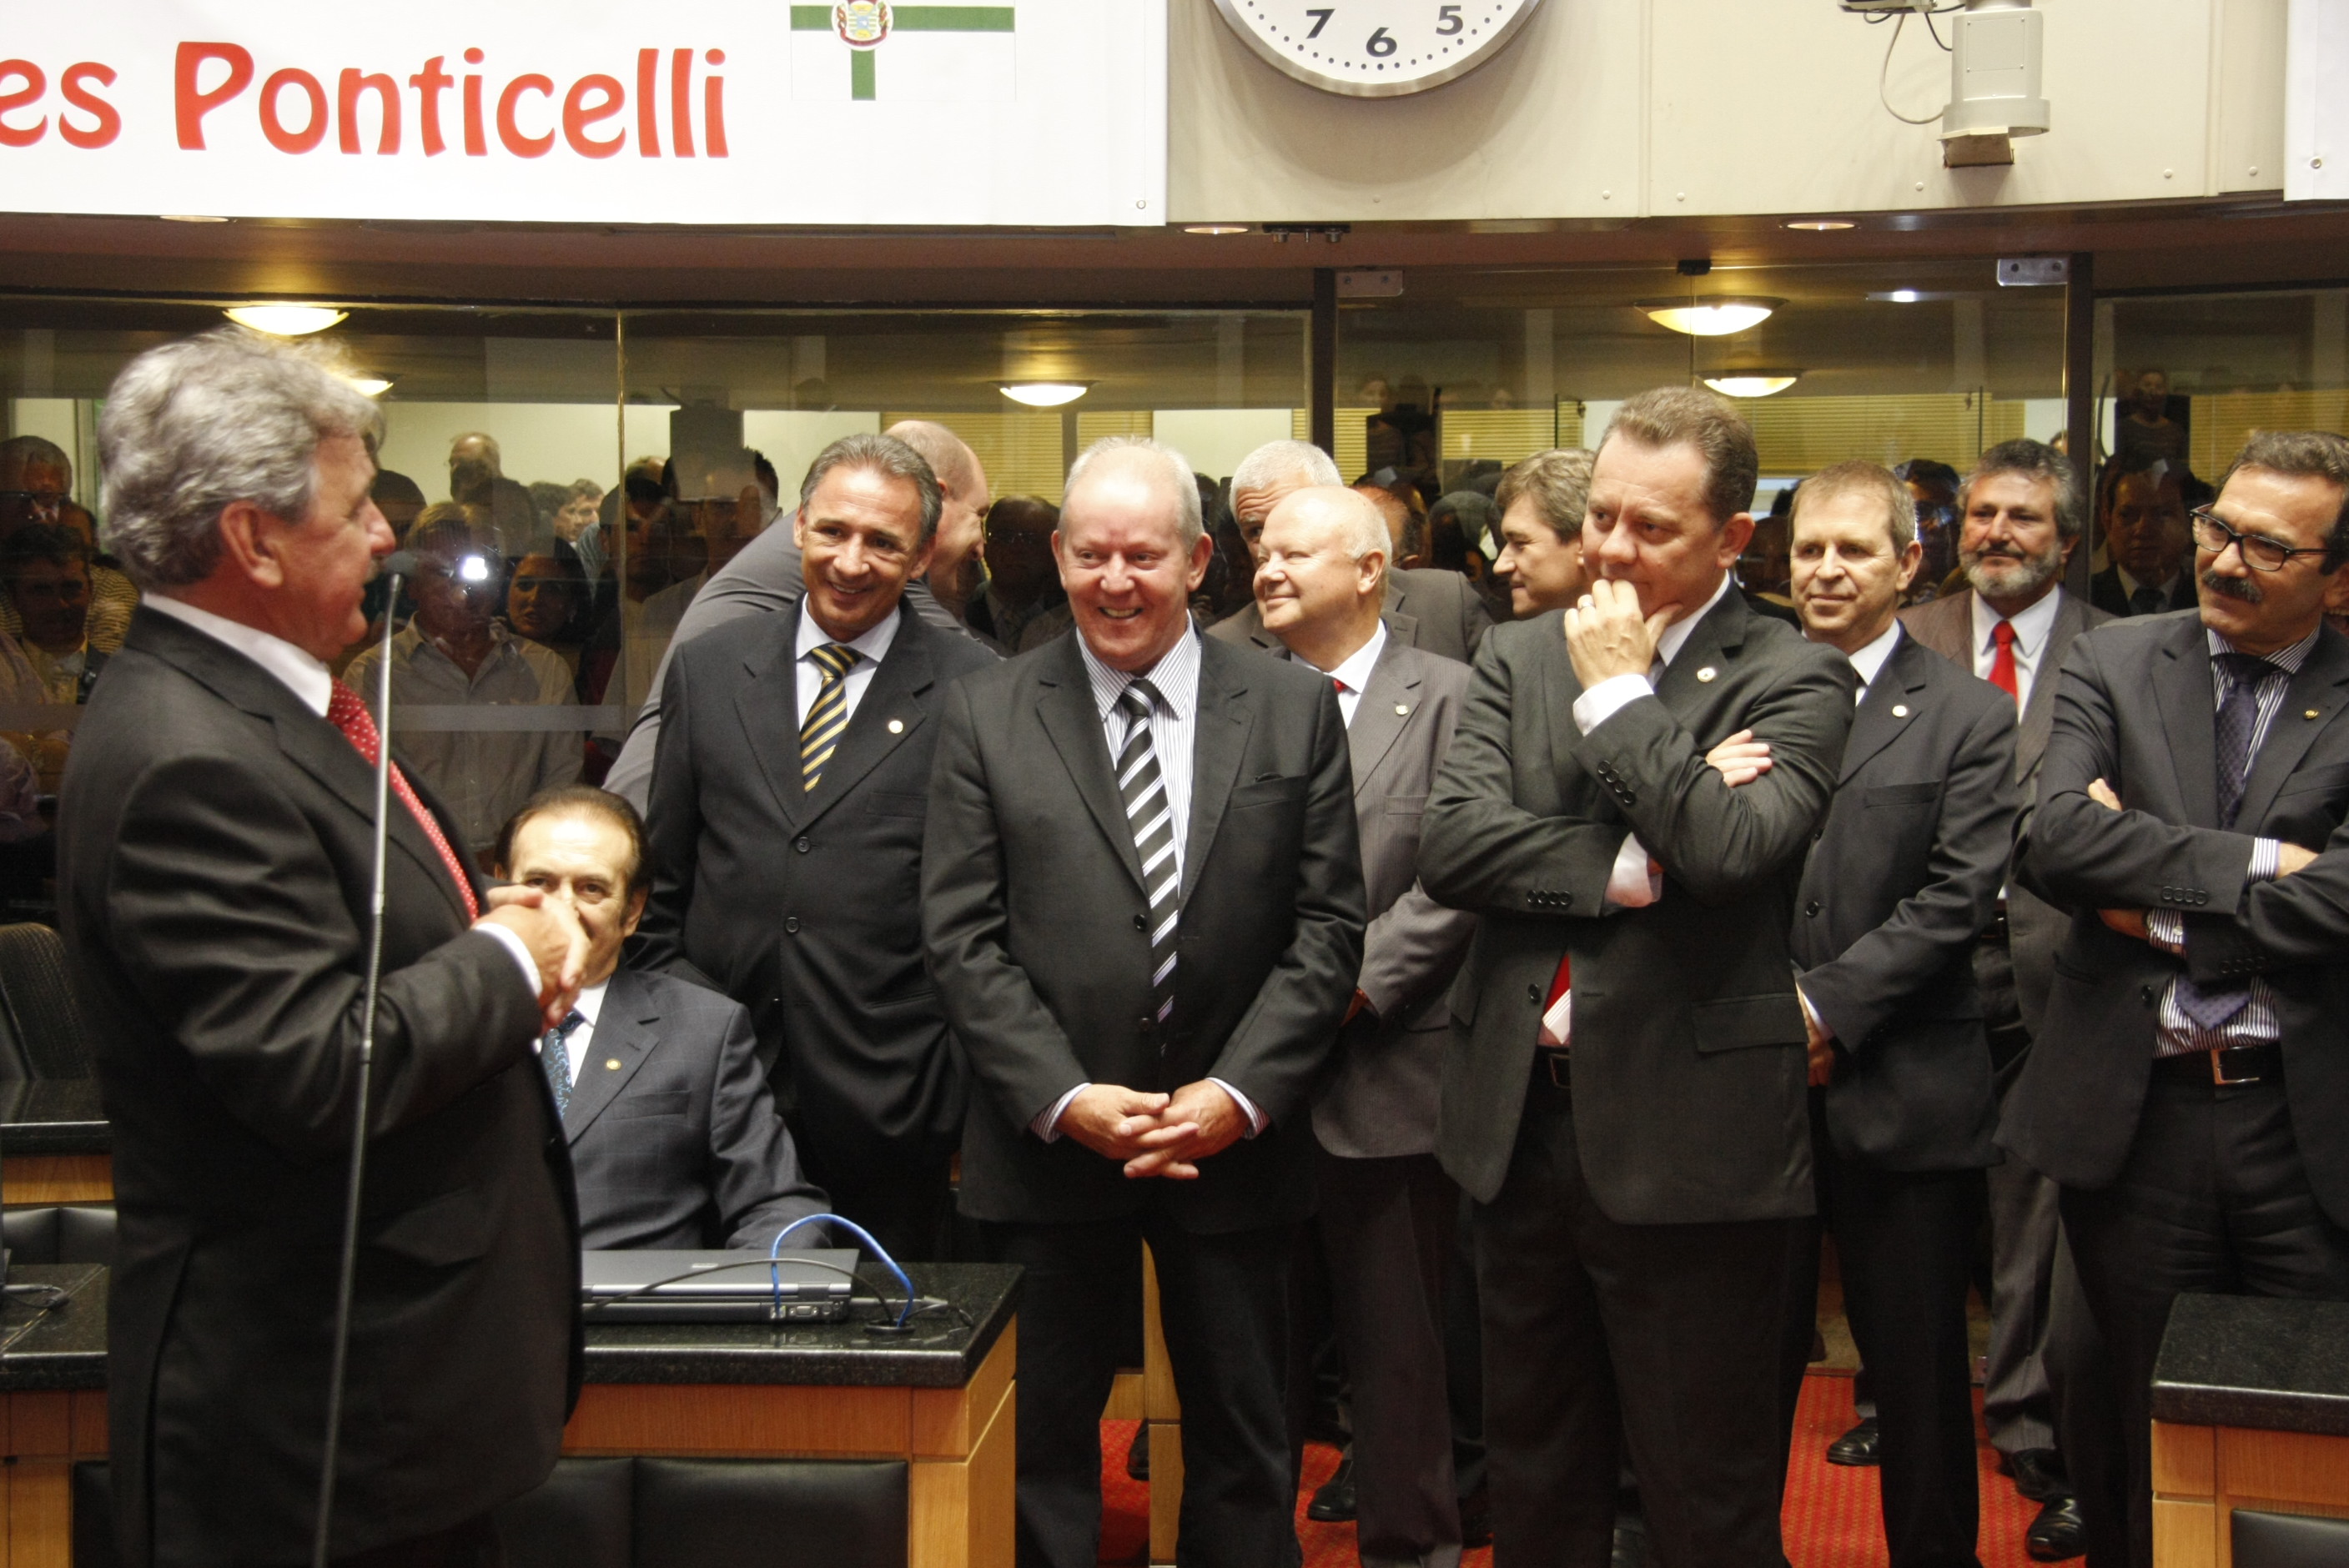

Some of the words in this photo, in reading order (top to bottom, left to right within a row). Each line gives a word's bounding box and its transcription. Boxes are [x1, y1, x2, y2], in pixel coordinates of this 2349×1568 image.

[1306, 9, 1335, 38] 7
[1436, 5, 1463, 36] 5
[1366, 27, 1397, 58] 6
[0, 58, 122, 149] es
[175, 41, 729, 159] Ponticelli
